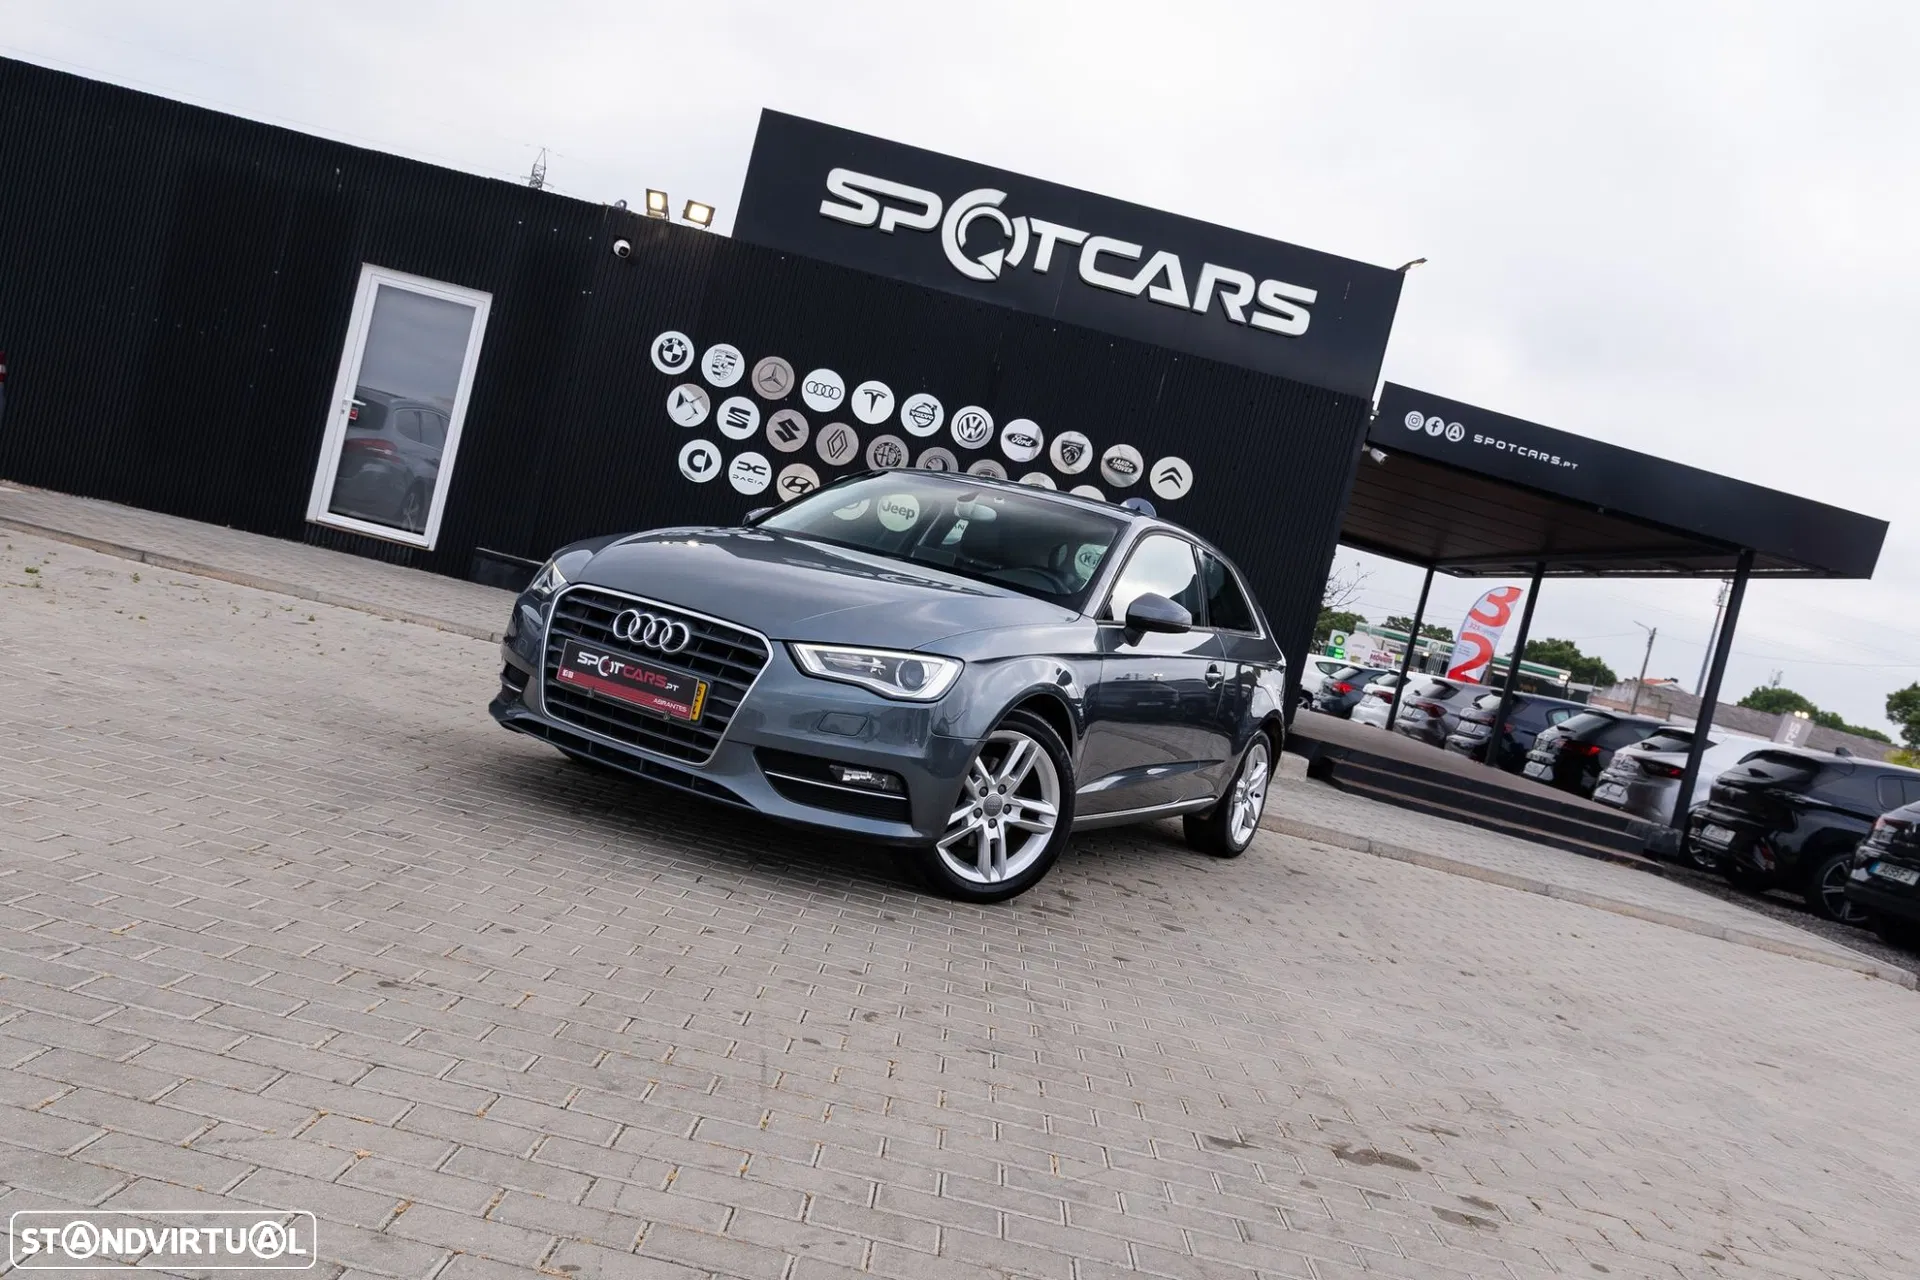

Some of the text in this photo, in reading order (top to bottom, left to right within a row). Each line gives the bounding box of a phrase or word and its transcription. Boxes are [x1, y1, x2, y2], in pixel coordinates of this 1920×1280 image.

[819, 167, 1319, 338] SPOTCARS
[911, 410, 934, 421] VOLVO
[1011, 433, 1034, 448] Ford
[1473, 433, 1579, 471] SPOTCARS.PT
[883, 499, 916, 521] Jeep
[653, 697, 688, 713] ABRANTES
